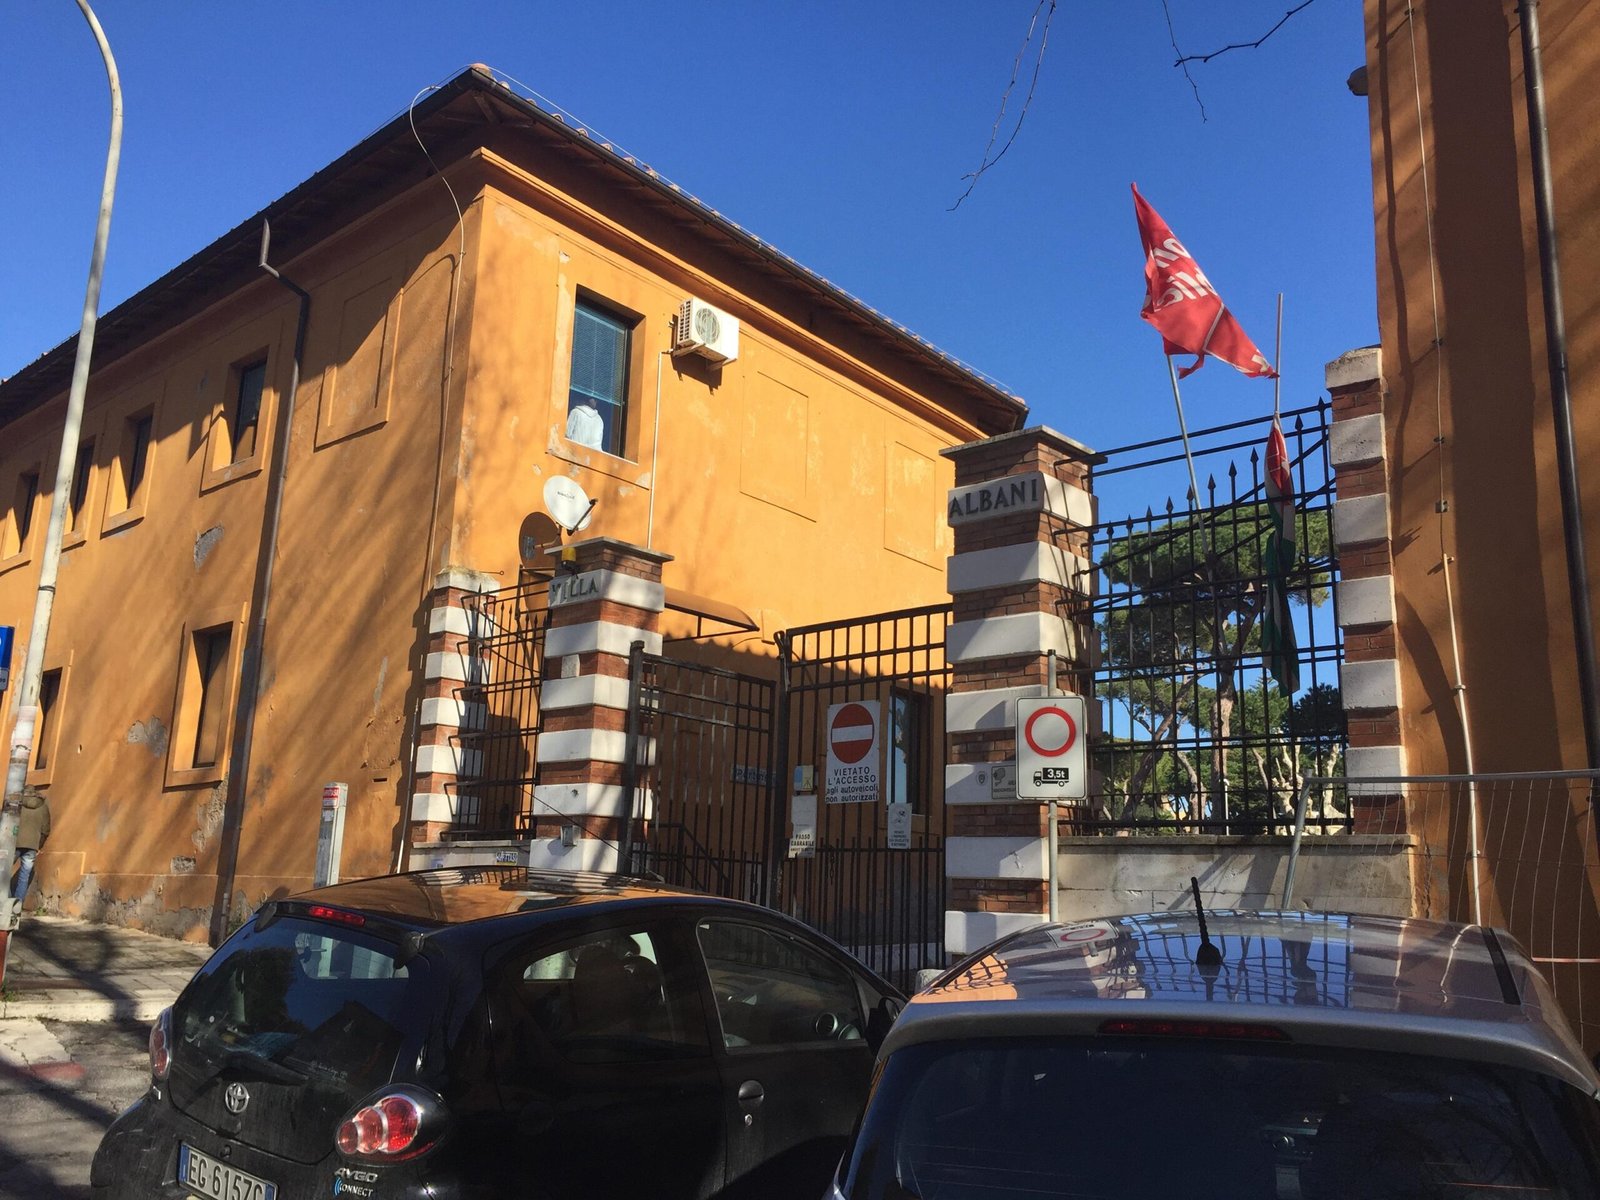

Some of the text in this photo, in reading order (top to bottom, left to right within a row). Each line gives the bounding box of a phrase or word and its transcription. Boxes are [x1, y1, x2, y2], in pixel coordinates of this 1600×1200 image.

[949, 479, 1038, 517] ALBANI
[551, 577, 599, 601] VILLA
[834, 766, 870, 776] VIETATO
[828, 774, 876, 786] L'ACCESSO
[827, 784, 879, 795] agli autoveicoli
[841, 792, 878, 802] autorizzati
[188, 1153, 207, 1188] EG
